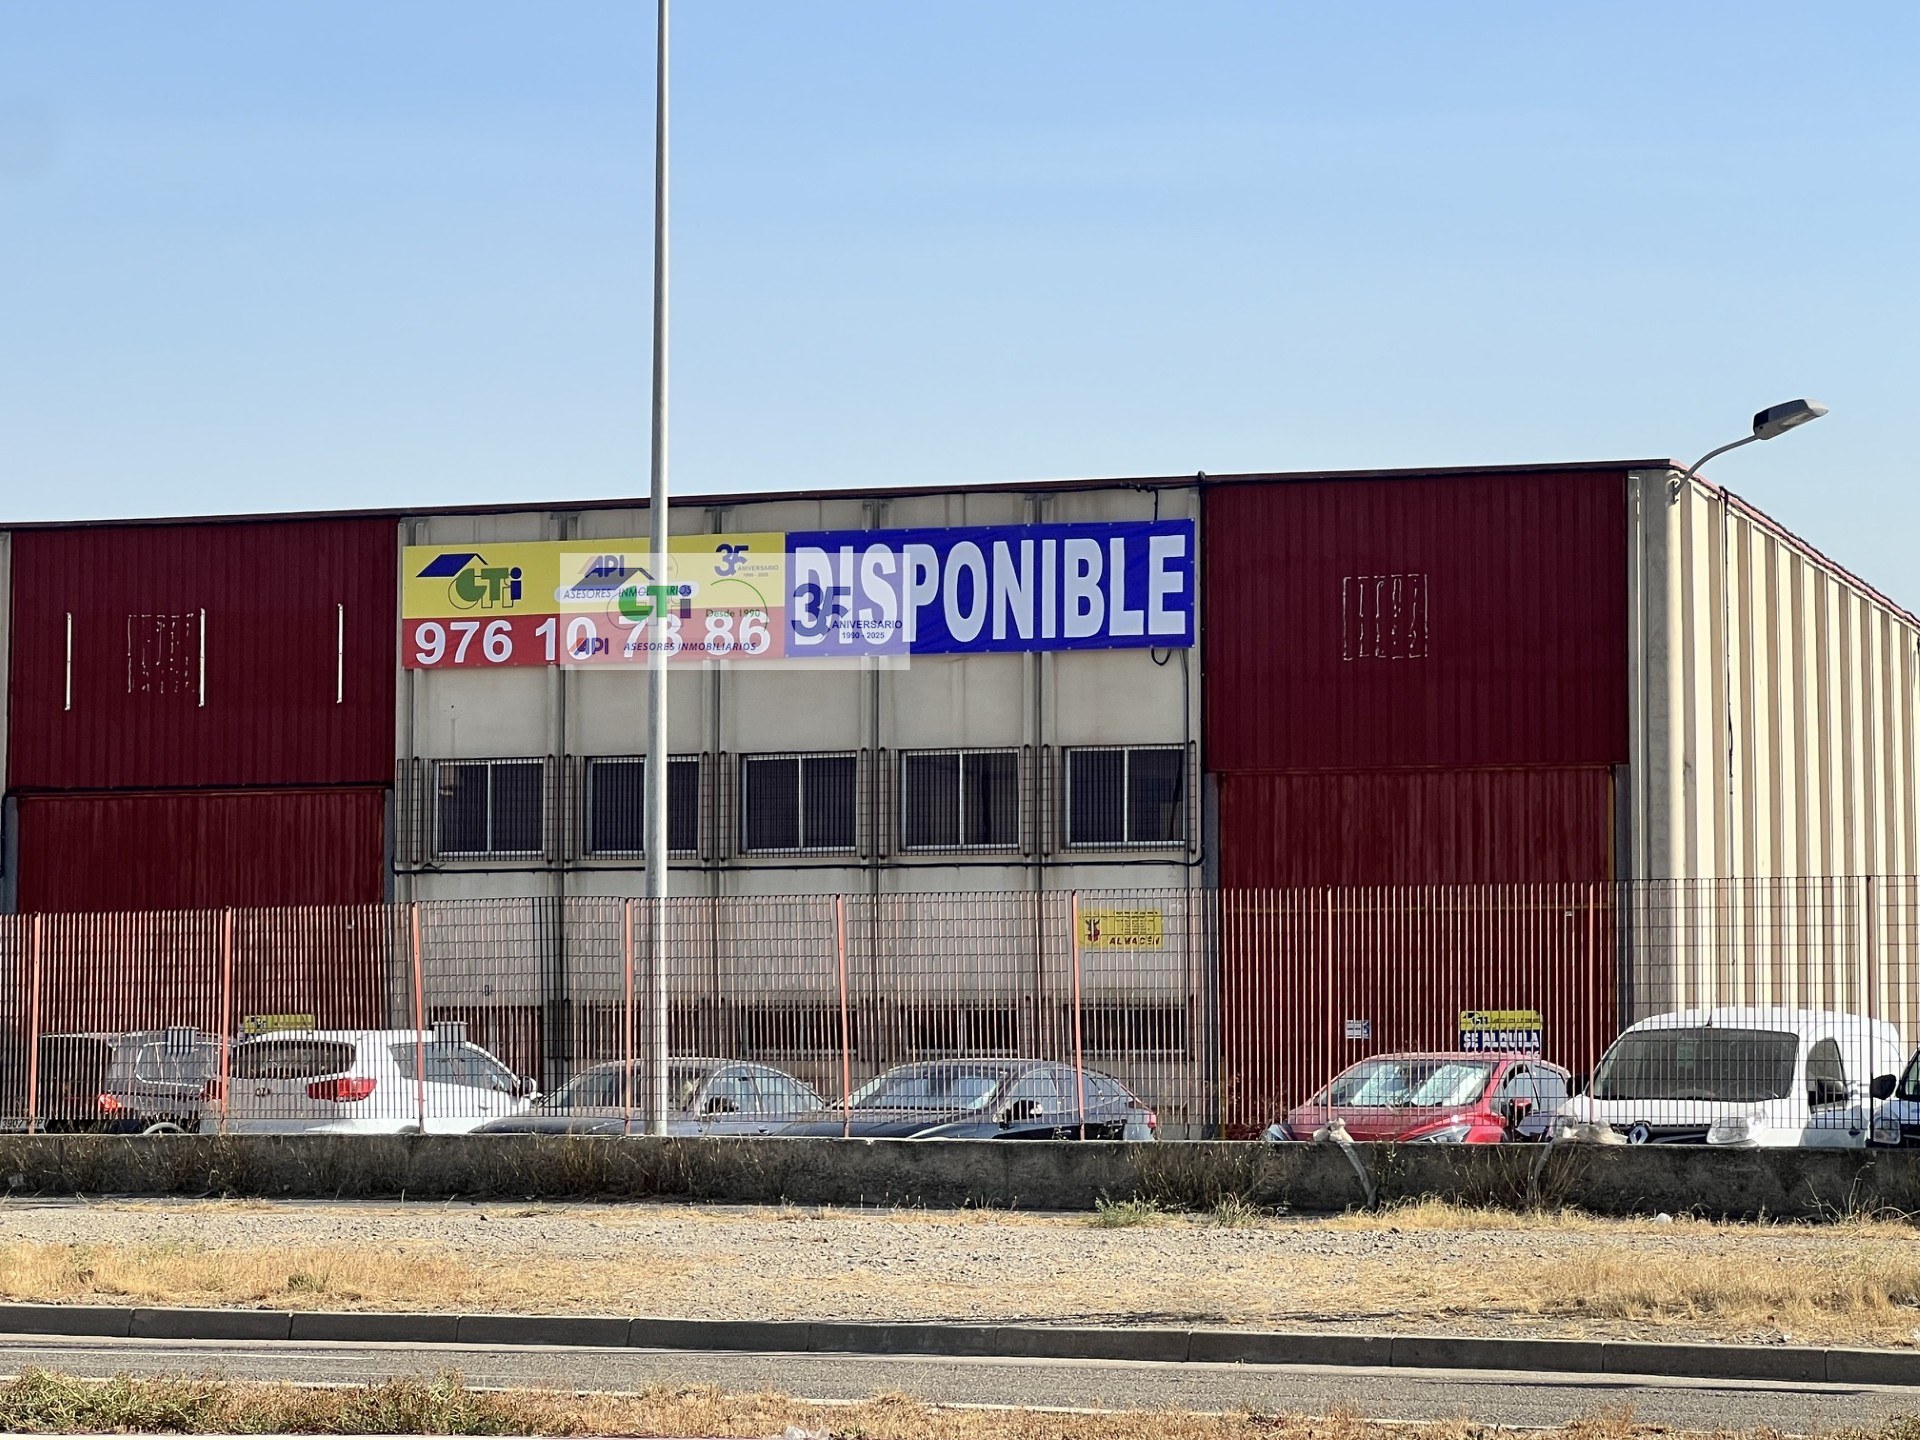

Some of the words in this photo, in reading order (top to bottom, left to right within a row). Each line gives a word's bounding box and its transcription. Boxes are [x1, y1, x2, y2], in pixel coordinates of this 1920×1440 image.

[578, 554, 625, 578] API
[714, 543, 749, 577] 35
[563, 588, 612, 599] ASESORES
[794, 534, 1187, 646] DISPONIBLE
[415, 618, 513, 665] 976
[535, 616, 597, 661] 10
[704, 611, 771, 656] 86
[1463, 1032, 1479, 1048] SE
[1482, 1032, 1540, 1048] ALQUILA
